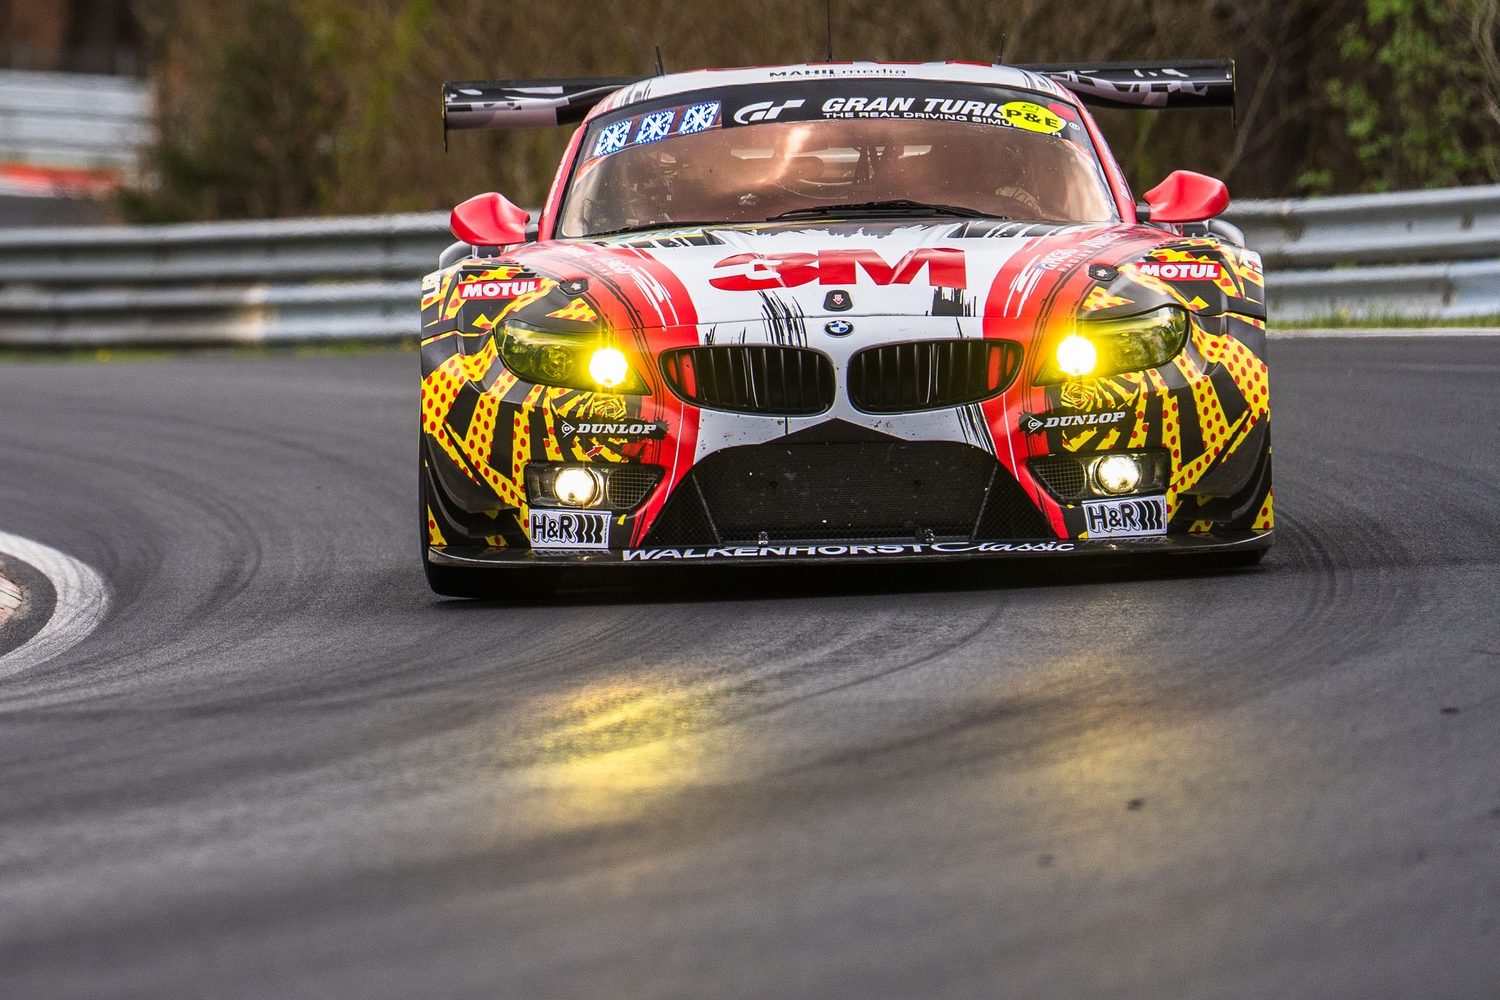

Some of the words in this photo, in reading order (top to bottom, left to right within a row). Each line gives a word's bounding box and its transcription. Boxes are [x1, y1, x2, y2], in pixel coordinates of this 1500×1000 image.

[821, 97, 916, 112] GRAN
[904, 112, 968, 121] DRIVING
[708, 247, 967, 291] 3M
[1139, 264, 1219, 279] MOTUL
[461, 281, 538, 299] MOTUL
[1044, 411, 1126, 428] DUNLOP
[576, 423, 657, 435] DUNLOP
[1087, 504, 1139, 533] H&R
[531, 514, 576, 543] H&R
[622, 543, 930, 561] WALKENHORST
[931, 541, 1075, 552] Classic
